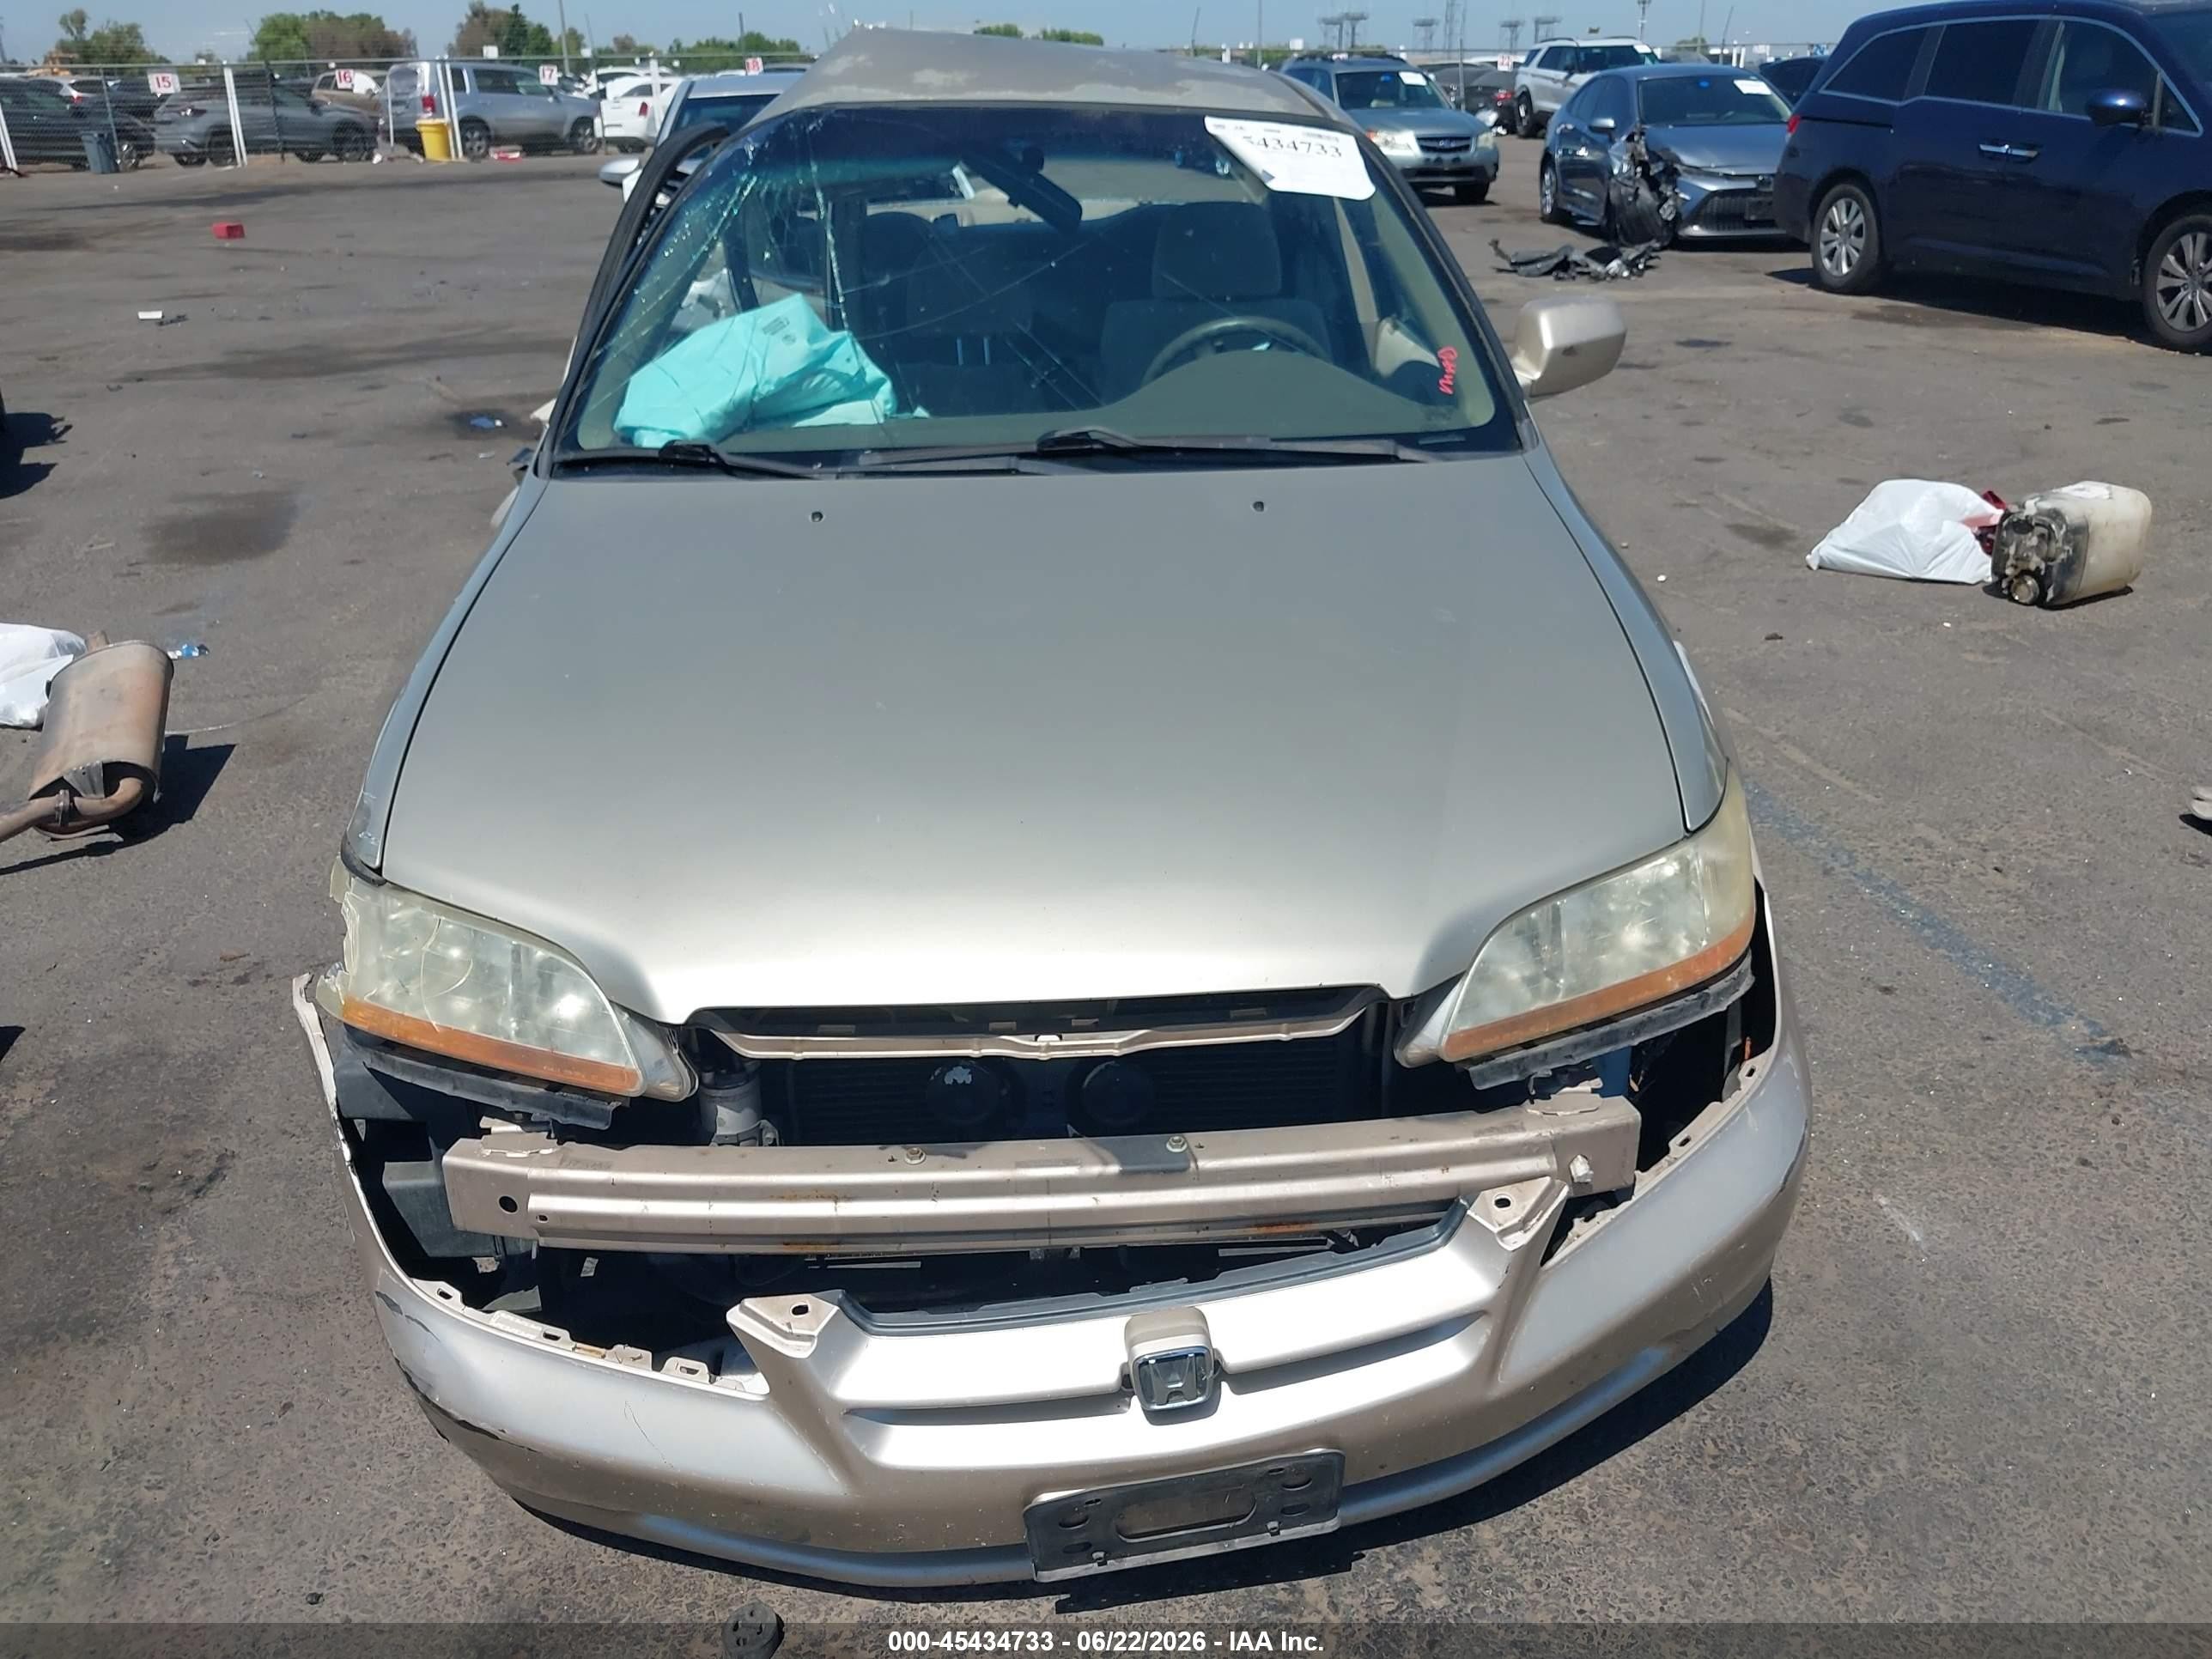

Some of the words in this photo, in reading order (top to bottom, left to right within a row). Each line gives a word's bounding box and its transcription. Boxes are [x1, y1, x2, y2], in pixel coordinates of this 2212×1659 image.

[337, 70, 352, 83] 16
[542, 68, 555, 78] 17
[155, 76, 172, 88] 15
